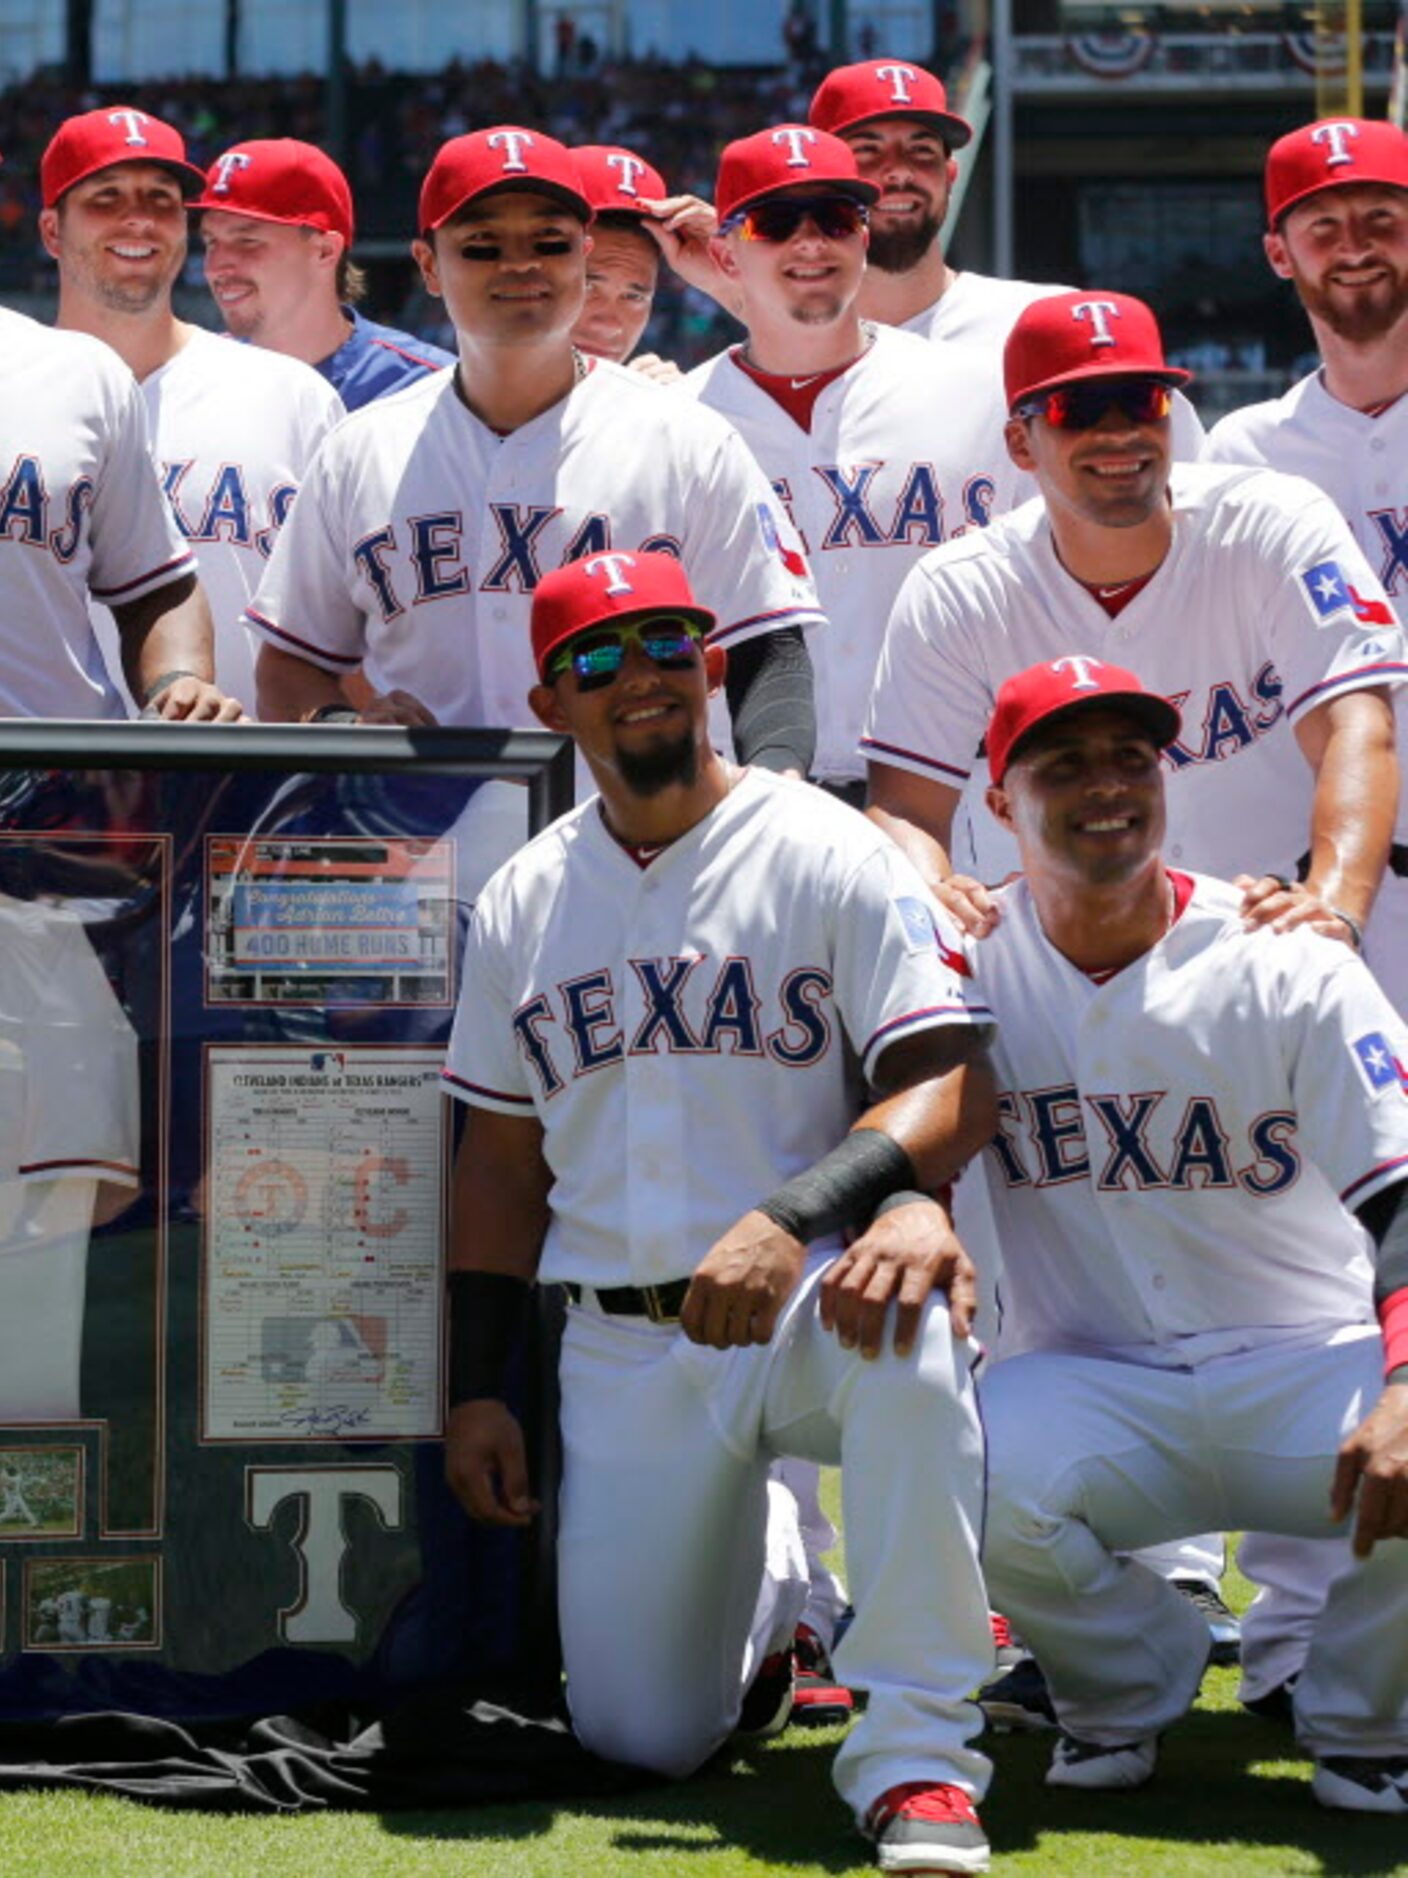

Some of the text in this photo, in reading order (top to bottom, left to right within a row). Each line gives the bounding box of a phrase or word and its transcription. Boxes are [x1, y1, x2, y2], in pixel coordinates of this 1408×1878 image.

[875, 64, 918, 105] T
[106, 110, 150, 147] T
[771, 128, 817, 168] T
[1309, 121, 1359, 167] T
[211, 152, 253, 195] T
[485, 130, 535, 174] T
[606, 153, 647, 198] T
[1070, 300, 1122, 349] T
[583, 552, 638, 597] T
[1051, 654, 1106, 691] T
[246, 933, 410, 955] 400 HOME RUNS
[511, 953, 834, 1101] TEXAS
[243, 1462, 406, 1646] T
